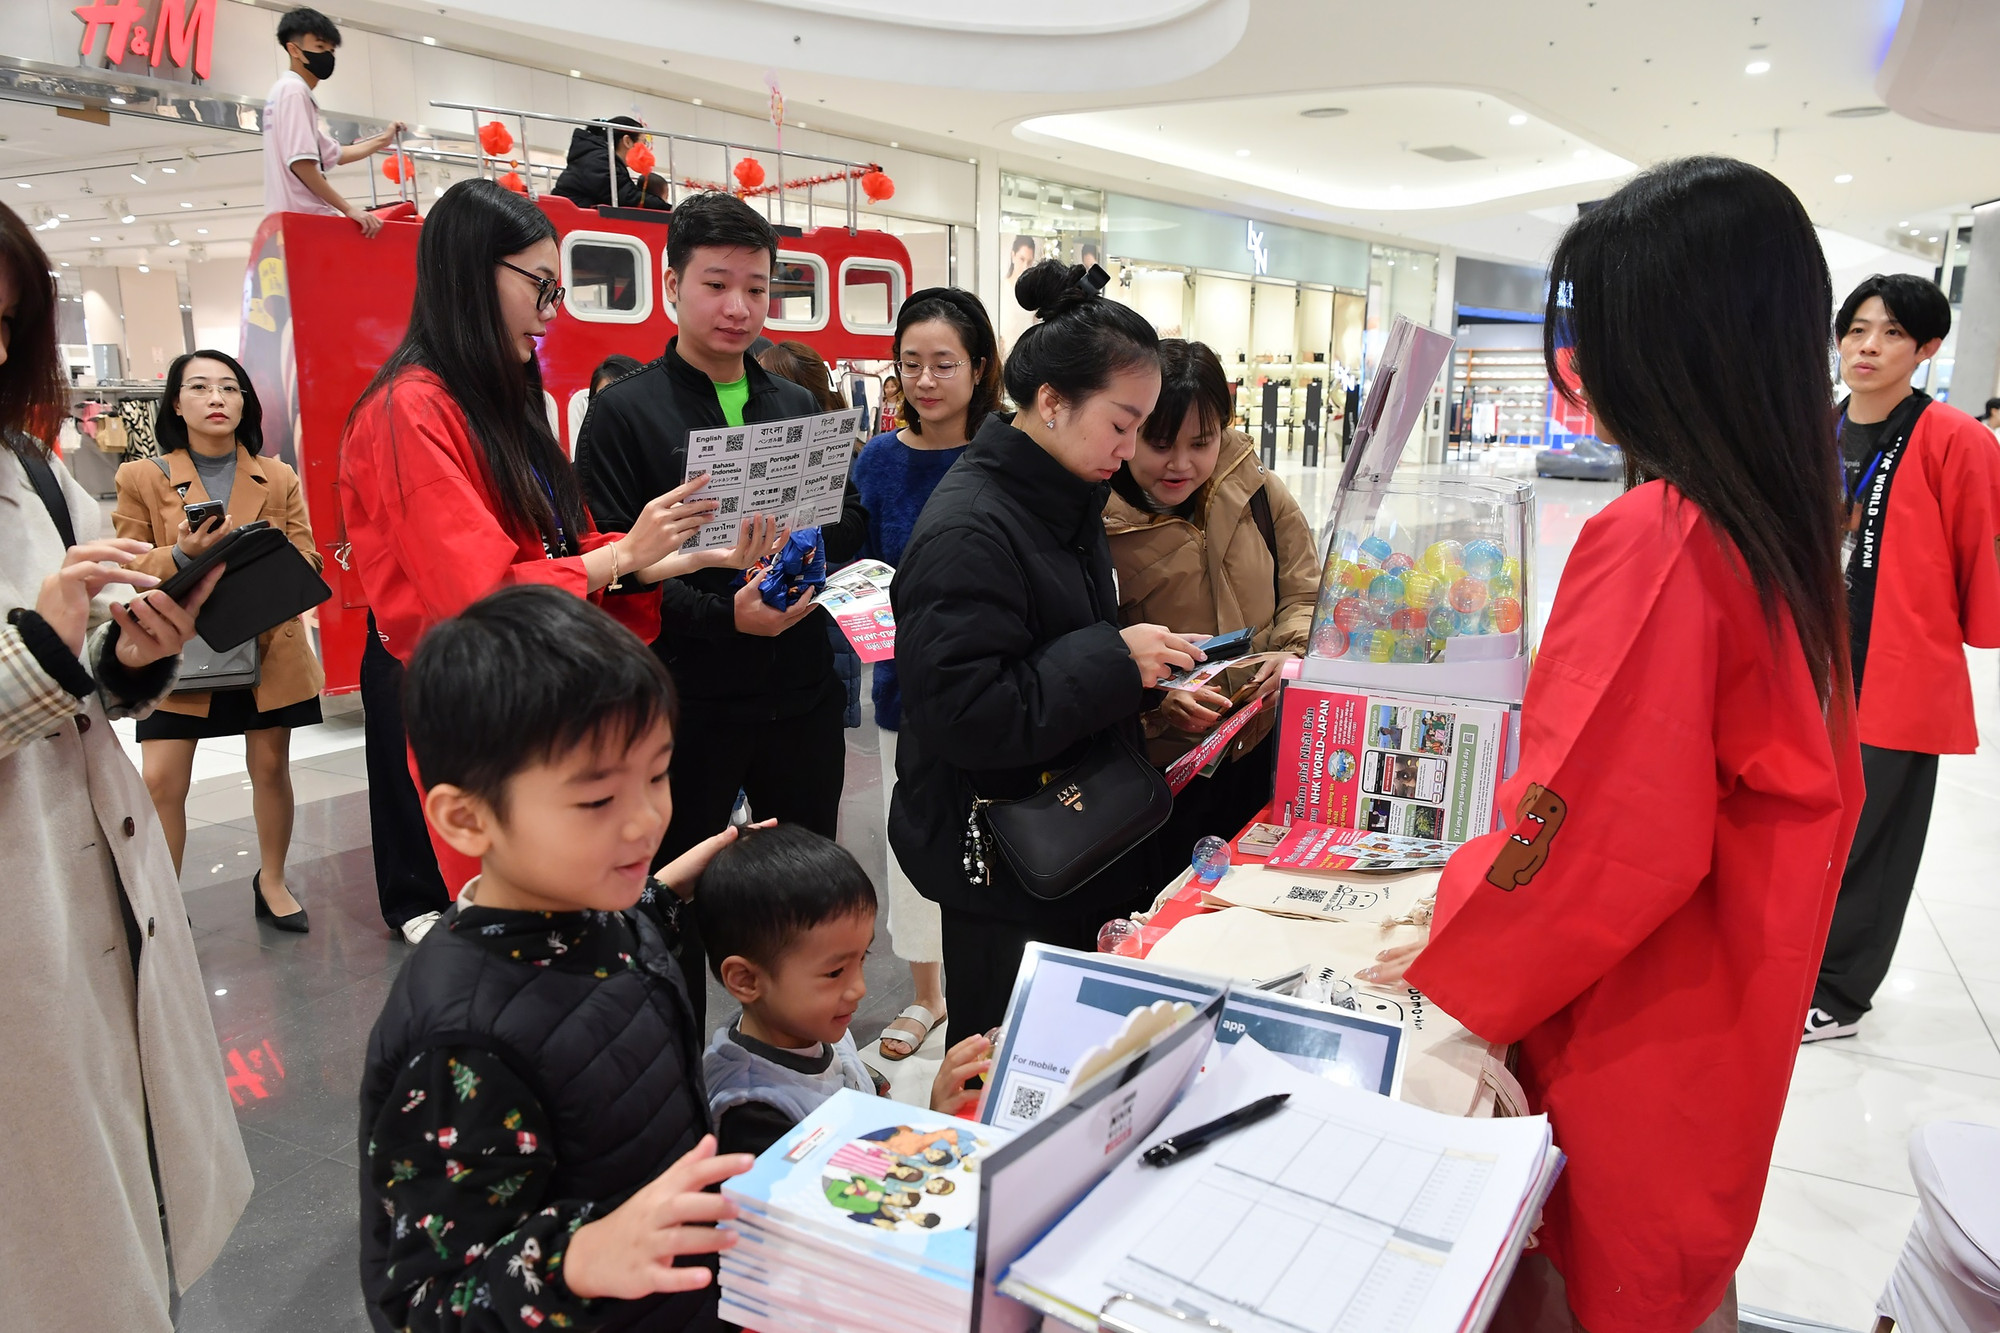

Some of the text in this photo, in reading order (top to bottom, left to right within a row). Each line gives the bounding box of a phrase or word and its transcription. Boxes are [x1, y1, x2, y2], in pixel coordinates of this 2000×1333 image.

[73, 0, 217, 80] H&M
[696, 435, 722, 443] English
[825, 441, 850, 452] Русский
[769, 452, 800, 464] Português
[711, 468, 742, 476] Indonesia
[804, 474, 829, 486] Español
[1867, 473, 1887, 516] WORLD
[1862, 529, 1875, 568] JAPAN
[1313, 699, 1330, 778] WORLD-JAPAN
[1294, 707, 1315, 818] Khám phá Nhật Bản
[1056, 784, 1078, 802] LYN
[1310, 781, 1322, 804] NHK
[1454, 828, 1462, 838] Tải
[1319, 967, 1335, 984] NH
[1222, 1019, 1246, 1034] app
[1012, 1054, 1071, 1076] For mobile de
